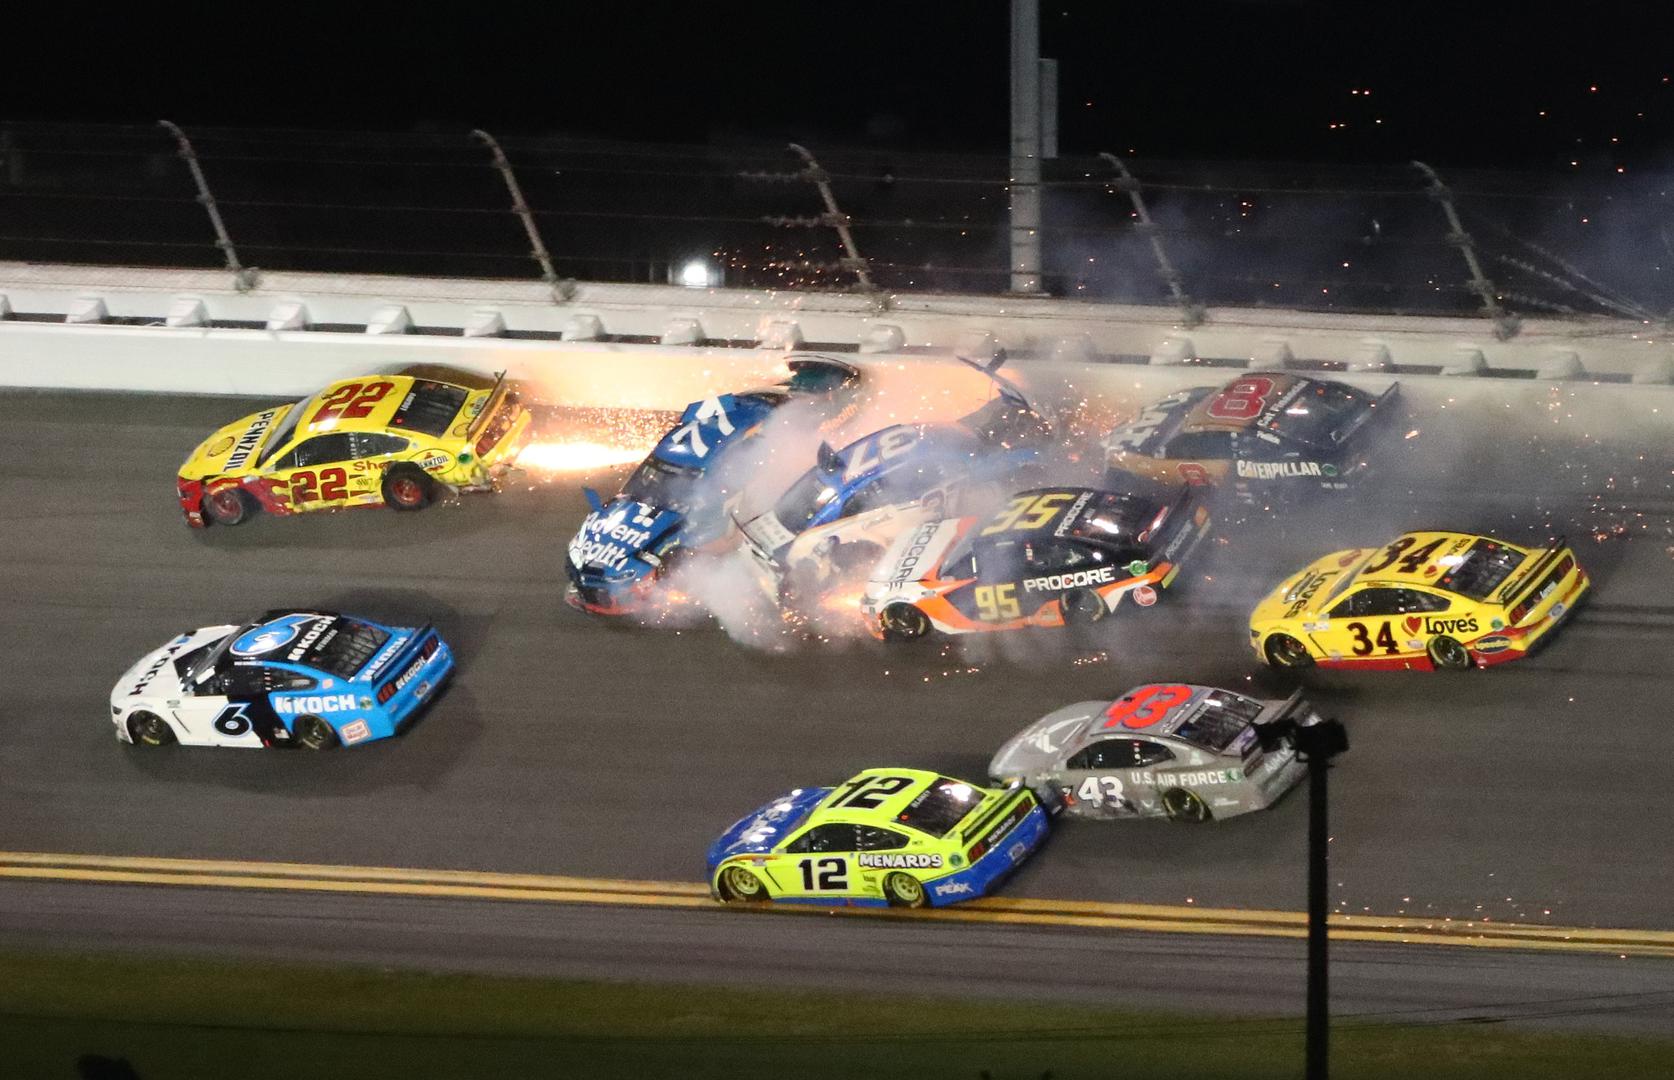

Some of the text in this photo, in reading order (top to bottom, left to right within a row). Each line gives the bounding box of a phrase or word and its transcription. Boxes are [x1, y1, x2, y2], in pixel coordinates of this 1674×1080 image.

[311, 382, 395, 422] 22
[1207, 377, 1276, 420] 8
[223, 412, 275, 472] PENNZOIL
[670, 393, 735, 458] 77
[289, 468, 348, 504] 22
[1237, 460, 1322, 479] CATERPILLAR
[1054, 491, 1094, 537] PROCORE
[1362, 538, 1449, 574] 34
[1023, 567, 1116, 592] PROCORE
[975, 583, 1021, 620] 95
[230, 612, 338, 656] 6
[1345, 621, 1401, 657] 34
[212, 703, 253, 739] 6
[1103, 685, 1192, 729] 43
[828, 776, 914, 809] 12
[1078, 776, 1126, 808] 43
[1131, 770, 1227, 787] U.S. AIR FORCE
[799, 858, 848, 890] 12
[859, 852, 943, 869] MENARDS
